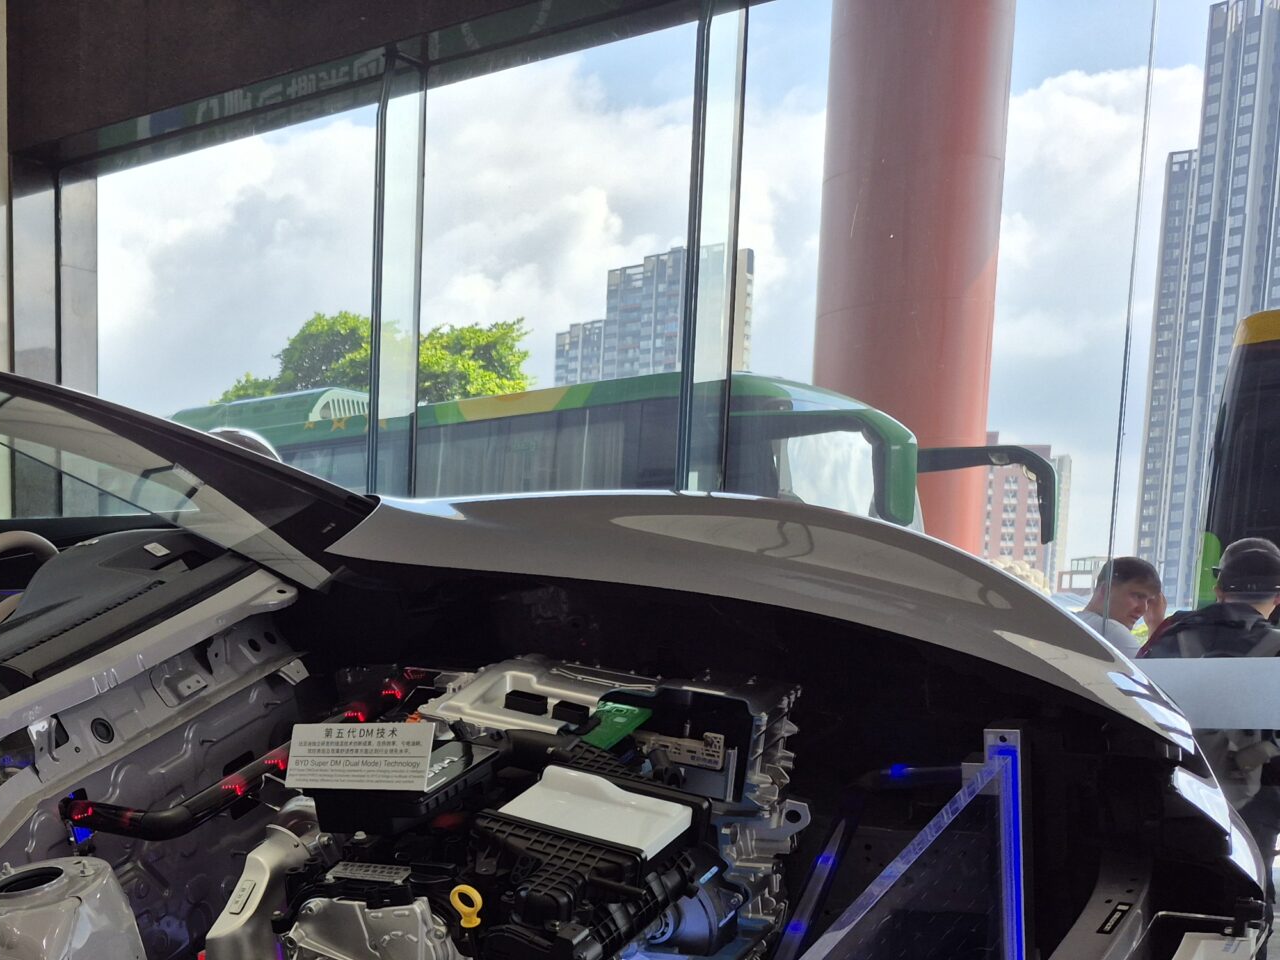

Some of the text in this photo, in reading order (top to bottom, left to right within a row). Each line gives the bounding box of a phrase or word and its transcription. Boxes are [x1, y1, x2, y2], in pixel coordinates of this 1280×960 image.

[324, 727, 398, 739] 第五代DM技术
[310, 760, 328, 768] Super
[343, 760, 359, 768] (Dual
[361, 760, 381, 769] Mode)
[384, 760, 420, 768] Technology
